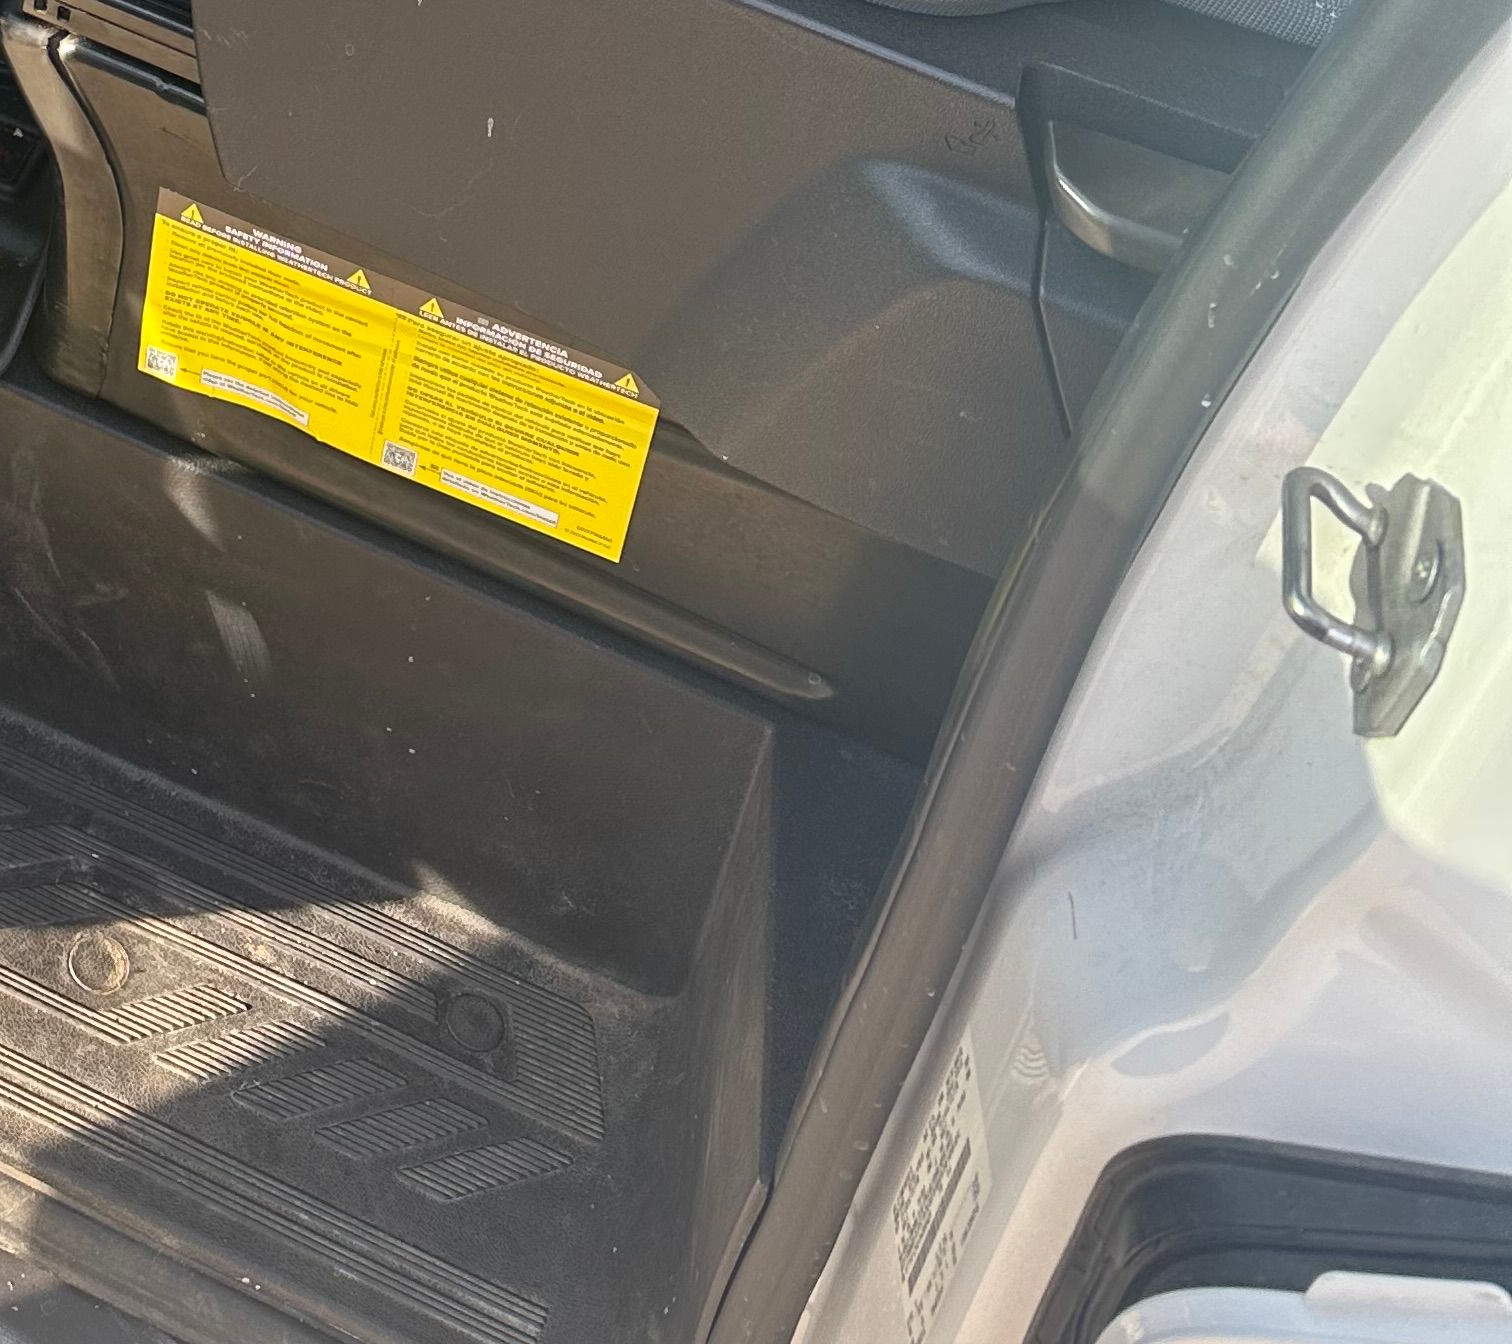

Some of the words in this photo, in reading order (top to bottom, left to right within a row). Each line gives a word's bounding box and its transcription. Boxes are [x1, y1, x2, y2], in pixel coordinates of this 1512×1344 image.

[225, 225, 262, 245] SAFETY
[262, 240, 329, 272] INFORMATION
[252, 228, 303, 254] WARNING
[491, 323, 569, 358] ADVERTENCIA
[528, 344, 542, 356] DE
[544, 350, 603, 379] SEGURIDAD
